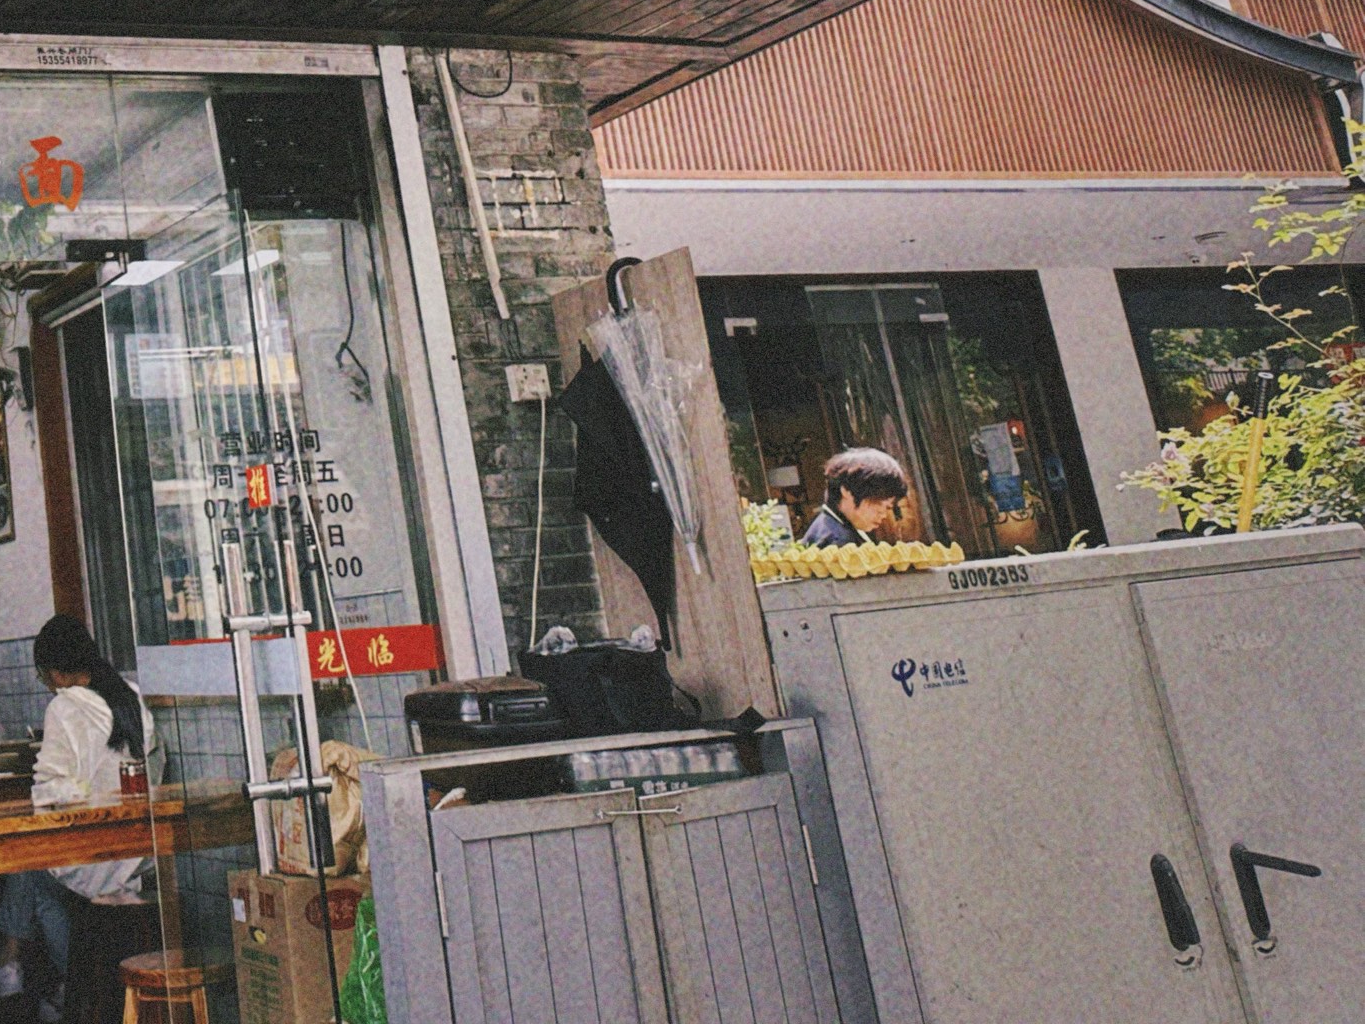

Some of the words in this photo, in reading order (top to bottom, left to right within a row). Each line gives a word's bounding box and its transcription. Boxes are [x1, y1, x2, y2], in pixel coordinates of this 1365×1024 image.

[220, 429, 320, 457] 营业时间
[248, 467, 268, 507] 推
[919, 658, 966, 681] 中国电信
